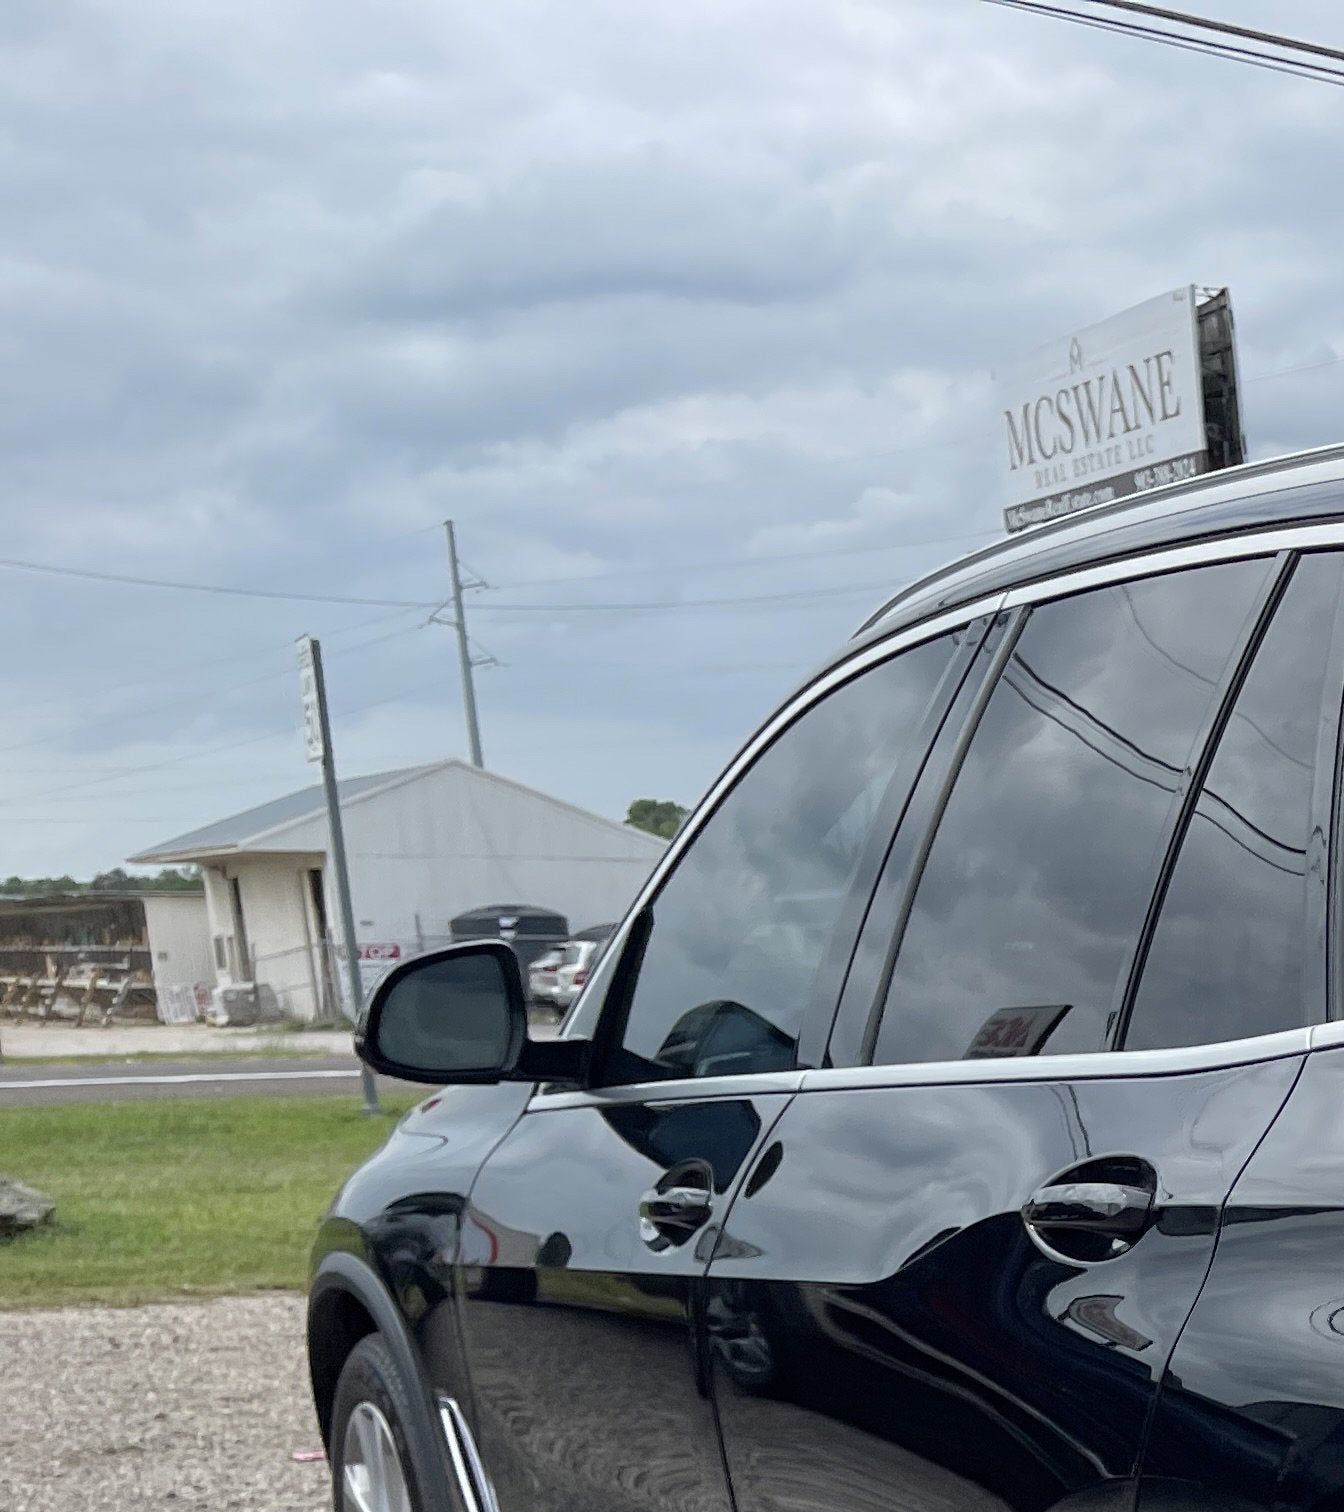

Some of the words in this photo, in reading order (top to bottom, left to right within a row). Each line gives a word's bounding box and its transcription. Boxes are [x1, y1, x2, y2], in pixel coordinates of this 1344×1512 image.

[1004, 350, 1181, 470] MCSWANE
[1072, 443, 1122, 478] ESTATE
[1129, 434, 1156, 461] LLC
